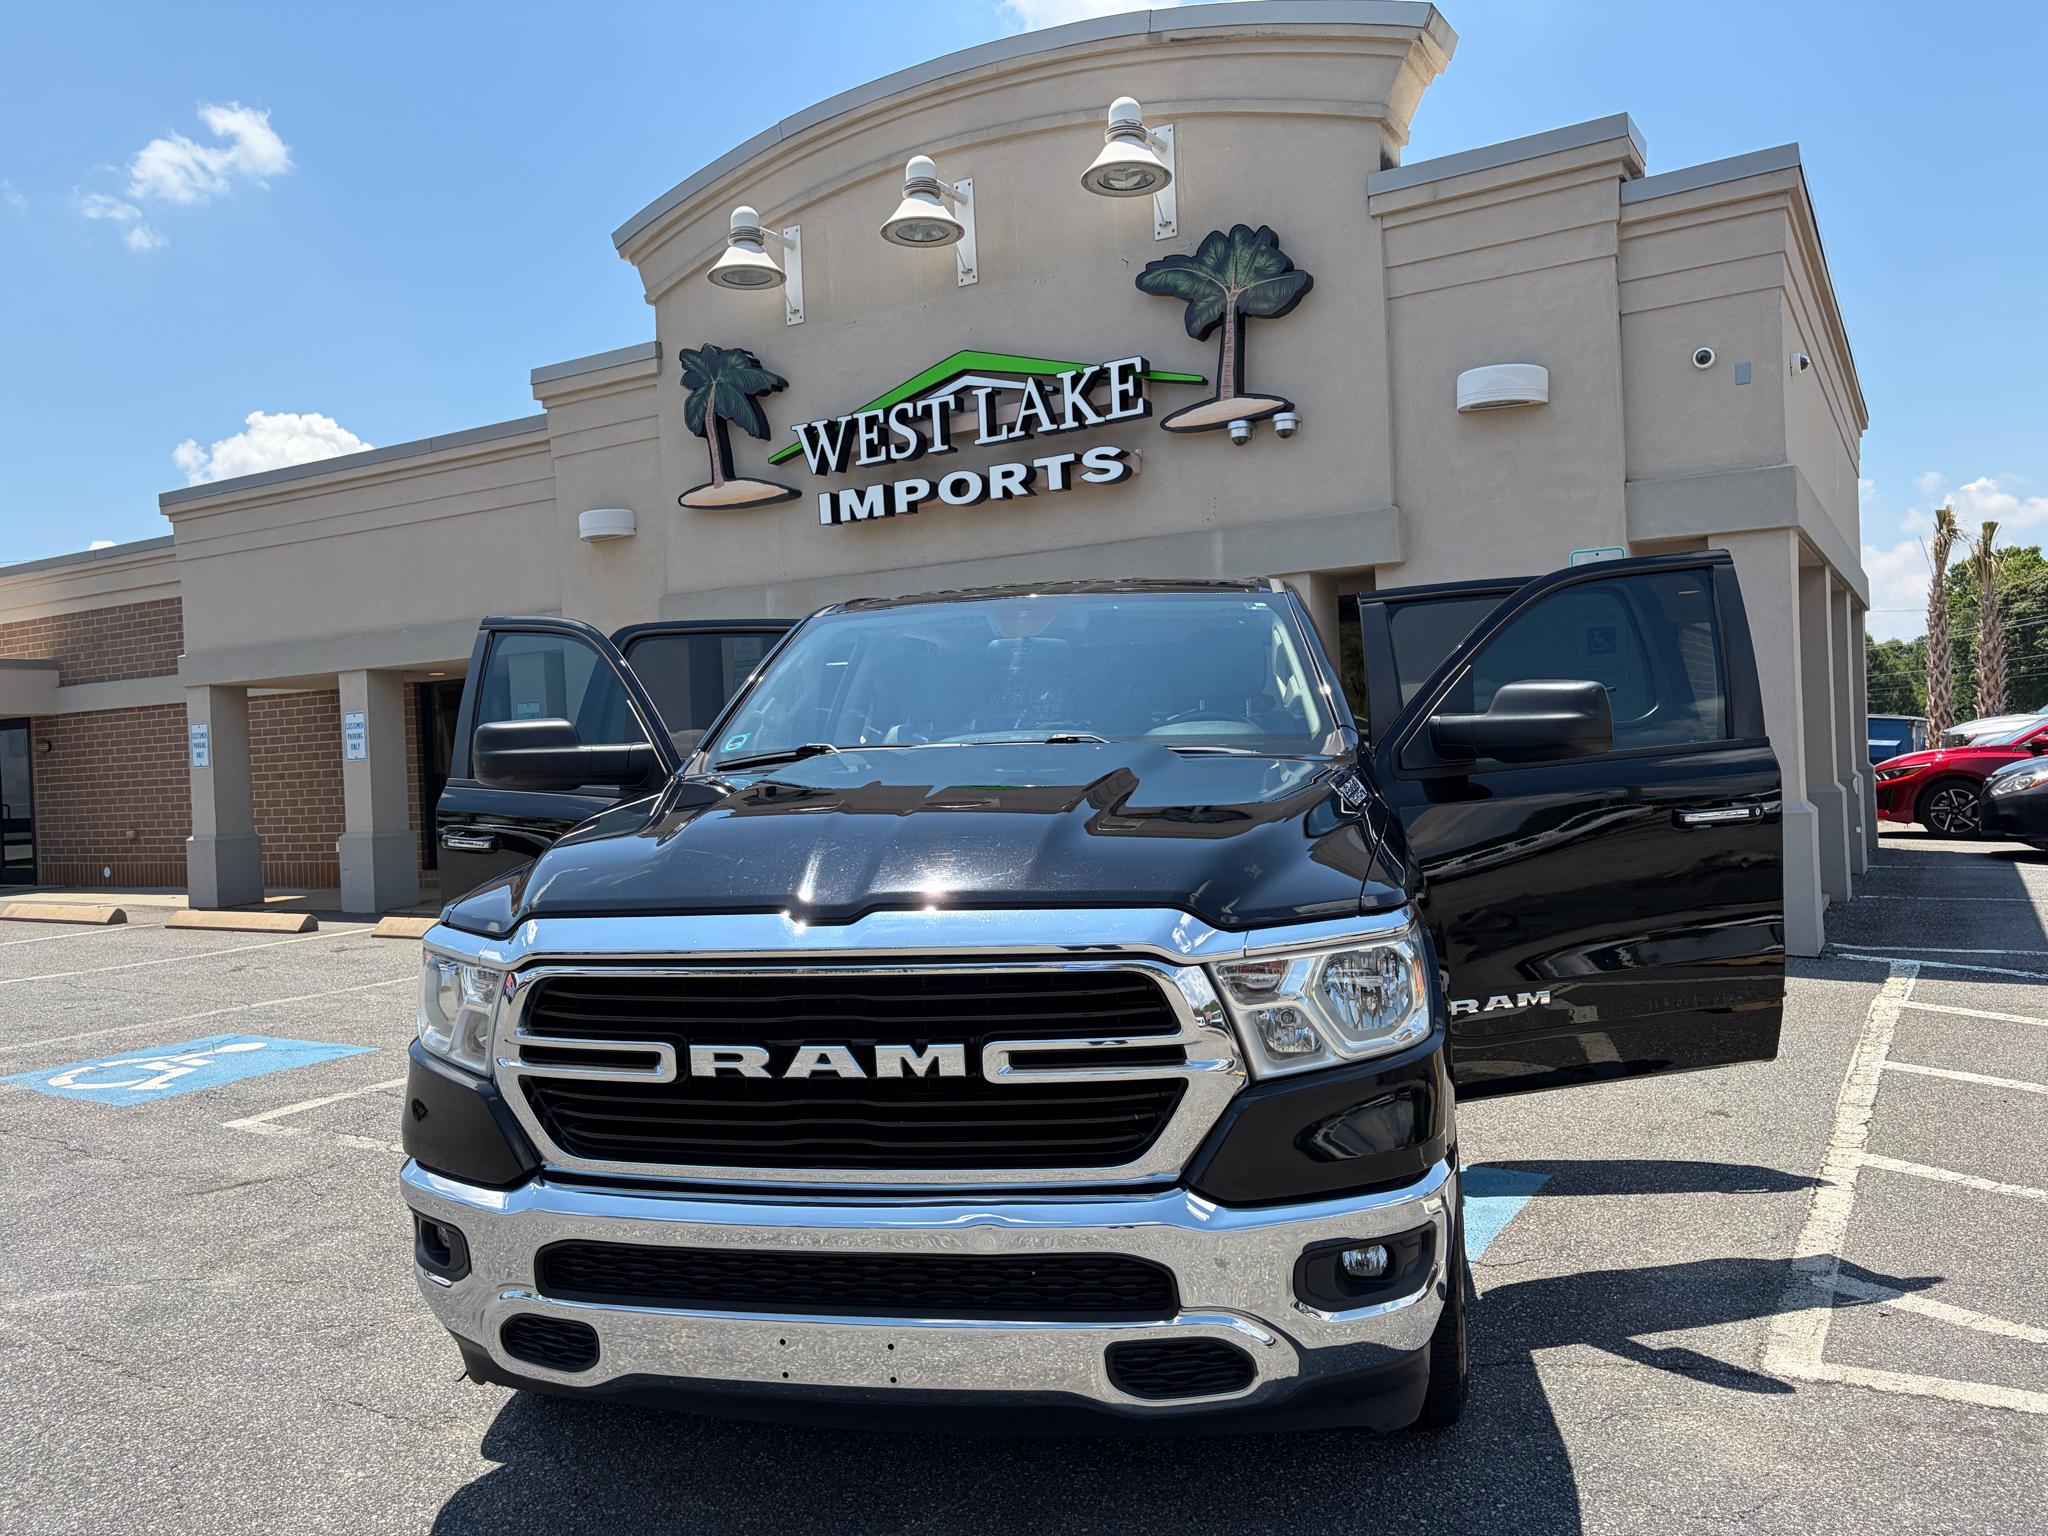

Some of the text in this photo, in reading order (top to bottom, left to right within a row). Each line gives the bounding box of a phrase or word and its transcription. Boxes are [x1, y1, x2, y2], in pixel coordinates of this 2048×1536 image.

[791, 356, 1148, 476] WEST LAKE
[818, 445, 1131, 526] IMPORTS
[193, 741, 207, 749] PARKING
[347, 732, 364, 741] PARKING
[350, 742, 361, 751] ONLY
[1451, 990, 1551, 1016] RAM
[689, 1044, 966, 1079] RAM
